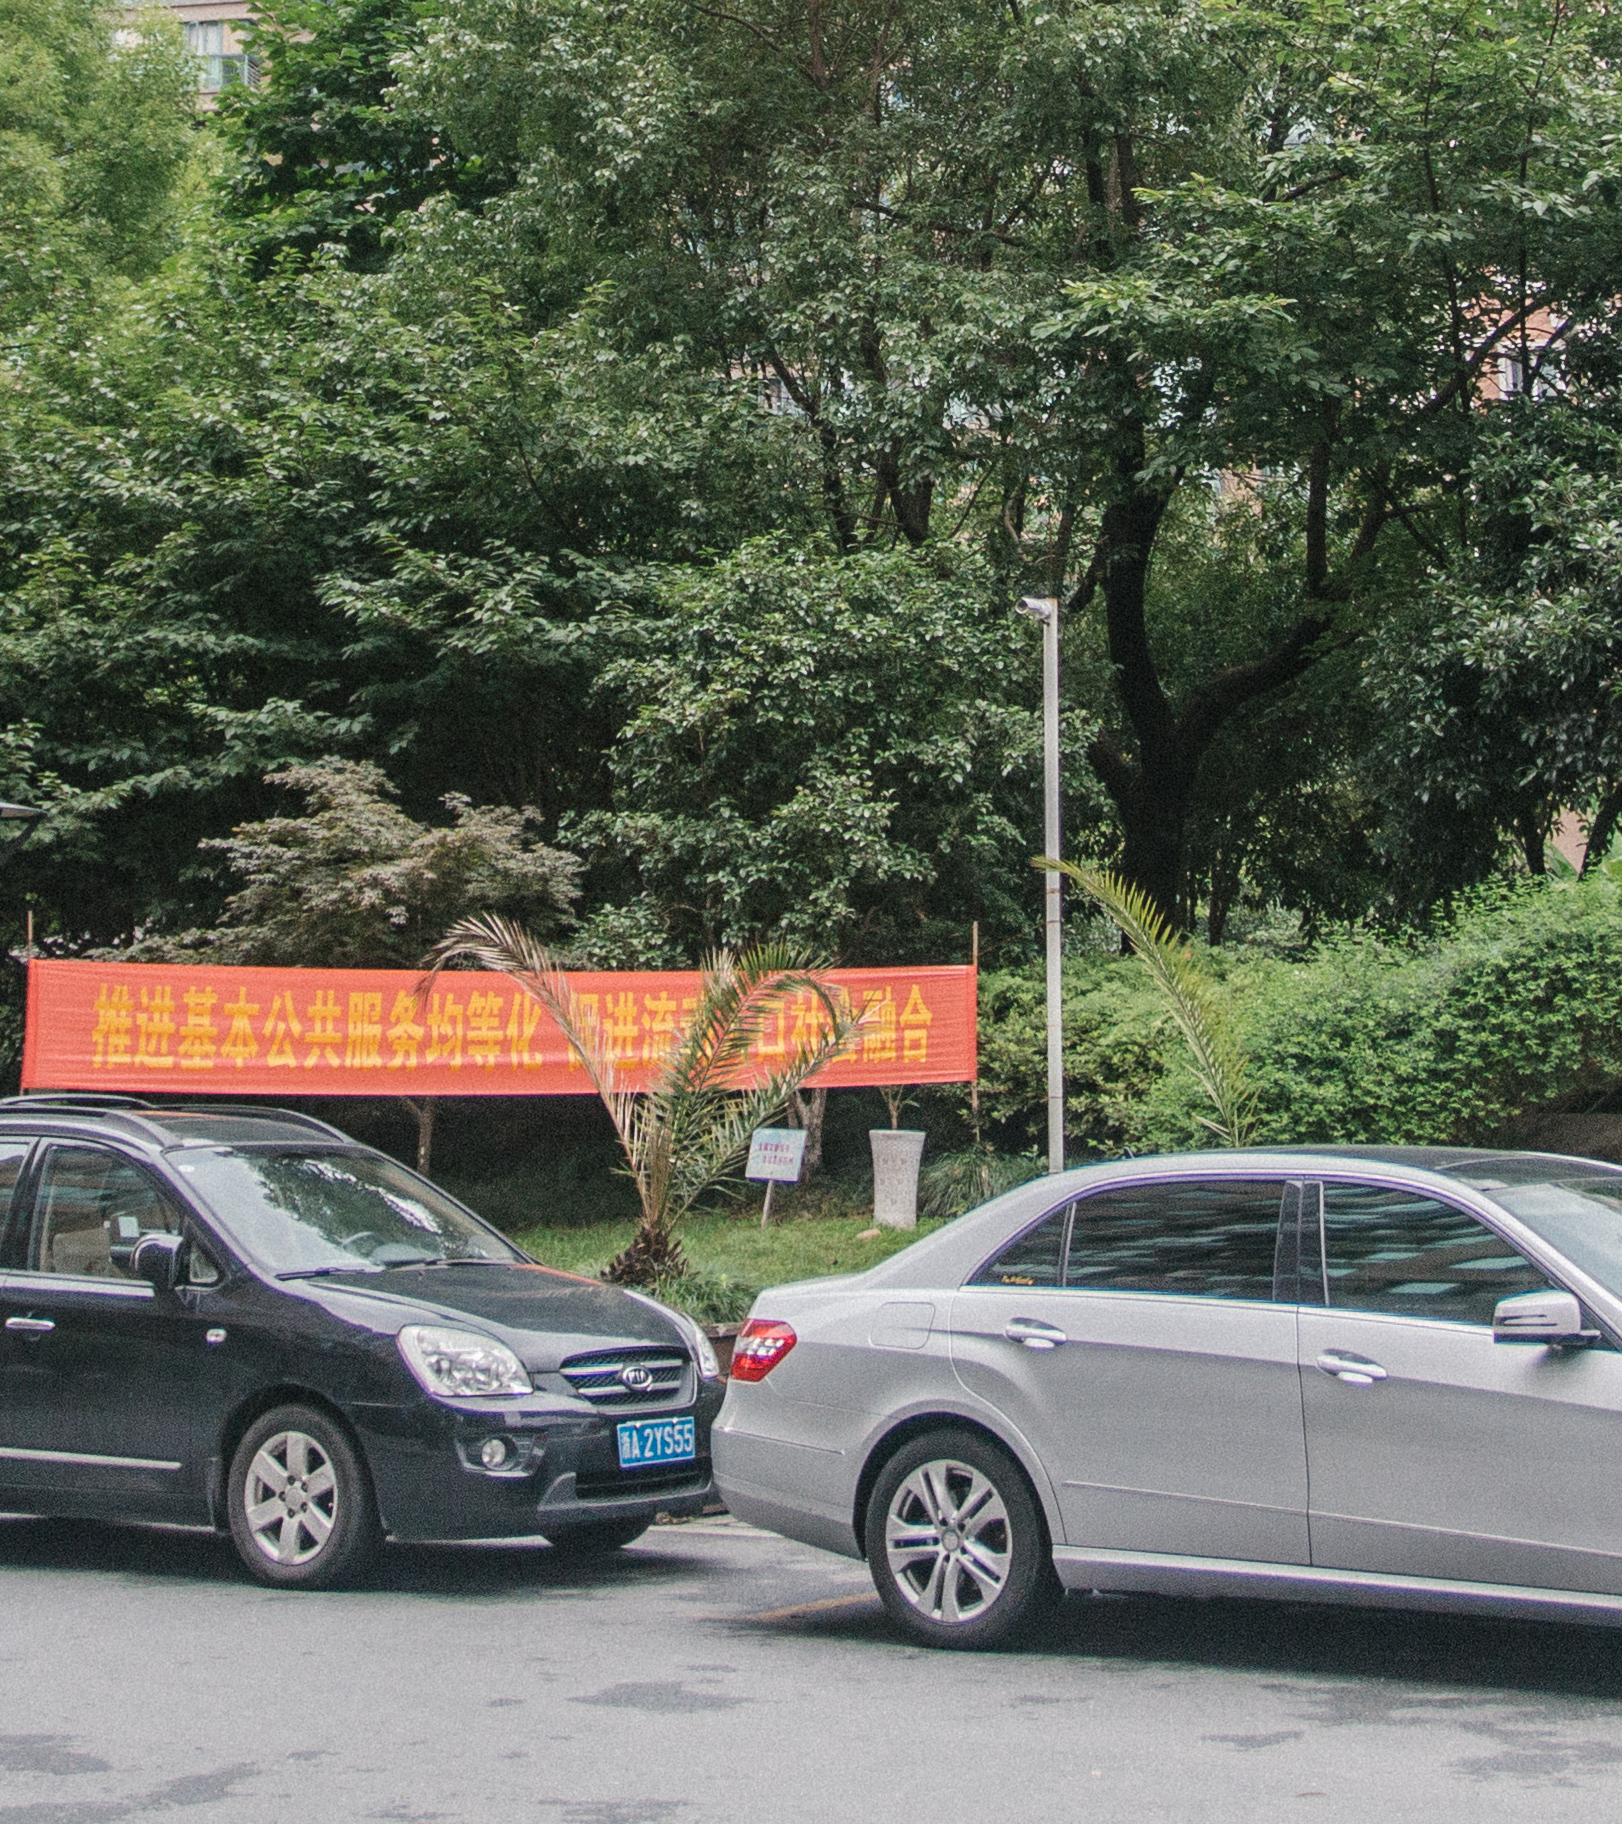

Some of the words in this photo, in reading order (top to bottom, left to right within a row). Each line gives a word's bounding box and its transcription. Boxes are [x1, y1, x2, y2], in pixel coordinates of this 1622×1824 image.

[92, 983, 542, 1073] 推进基本公共服务均等化
